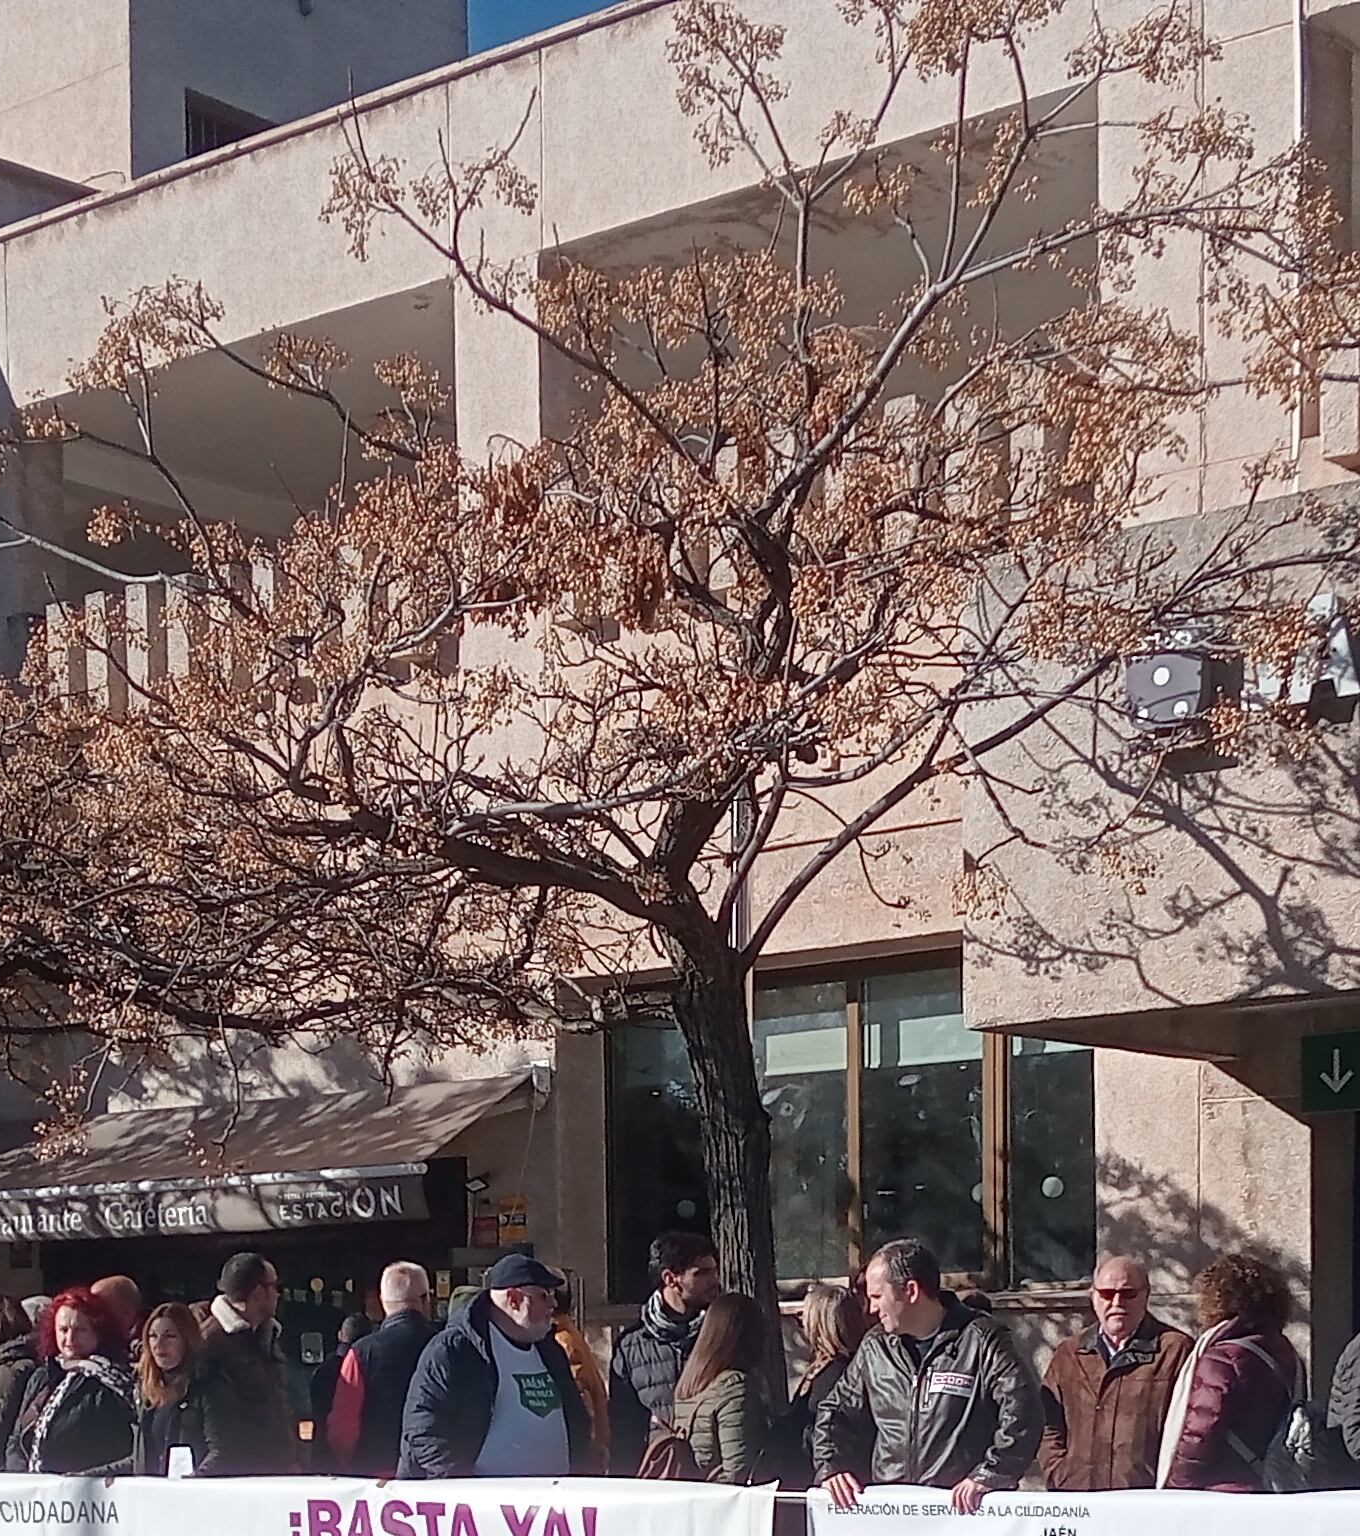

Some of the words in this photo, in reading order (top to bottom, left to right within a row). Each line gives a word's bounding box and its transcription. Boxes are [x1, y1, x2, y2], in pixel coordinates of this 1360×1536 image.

[103, 1196, 208, 1231] Cafetería
[0, 1500, 119, 1524] CIUDADANA
[903, 1504, 918, 1516] DE
[987, 1506, 997, 1517] A
[998, 1506, 1012, 1517] LA
